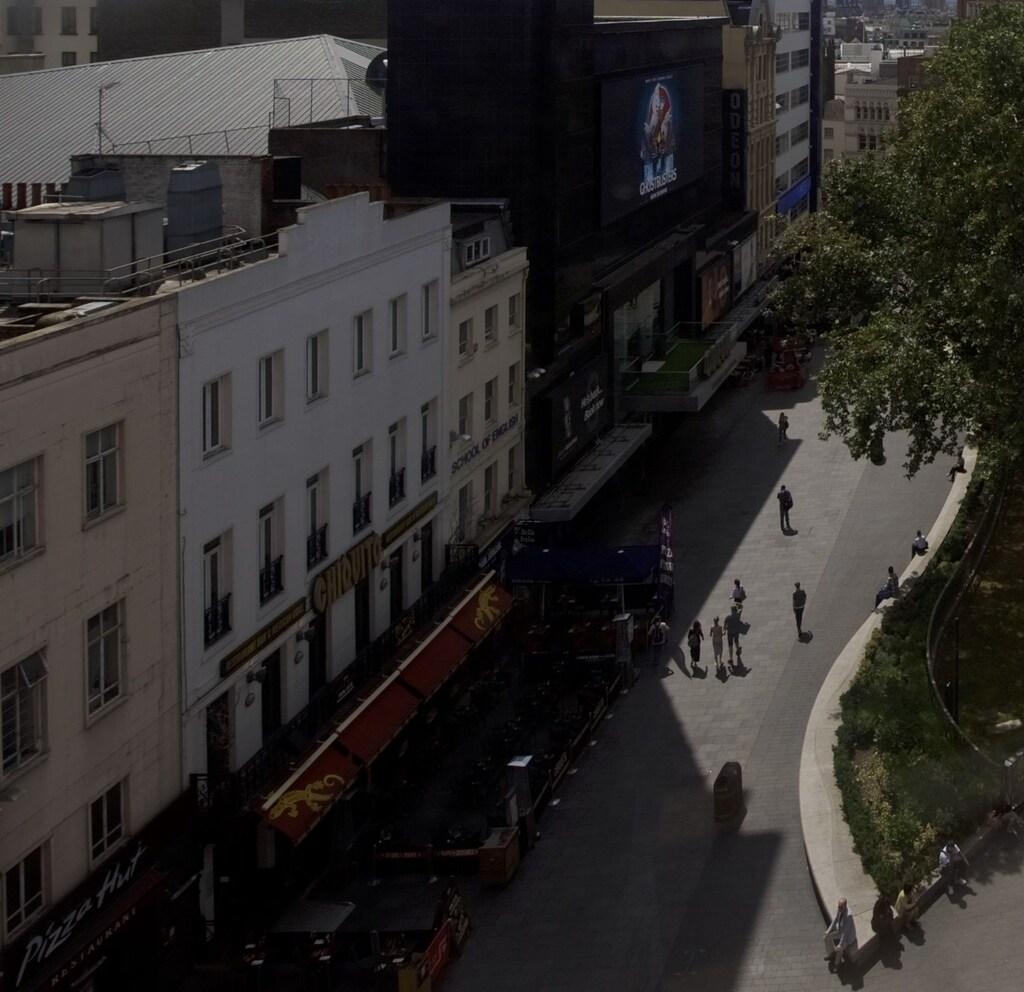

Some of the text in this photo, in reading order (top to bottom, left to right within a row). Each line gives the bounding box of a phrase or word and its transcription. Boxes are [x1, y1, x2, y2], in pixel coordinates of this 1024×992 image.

[640, 167, 678, 196] GHOSTBUSTERS
[730, 92, 742, 189] ODEON
[451, 413, 519, 474] SCHOOL OF ENGLISH
[312, 532, 385, 614] CHIQUITO
[16, 840, 149, 987] Pizza Hut
